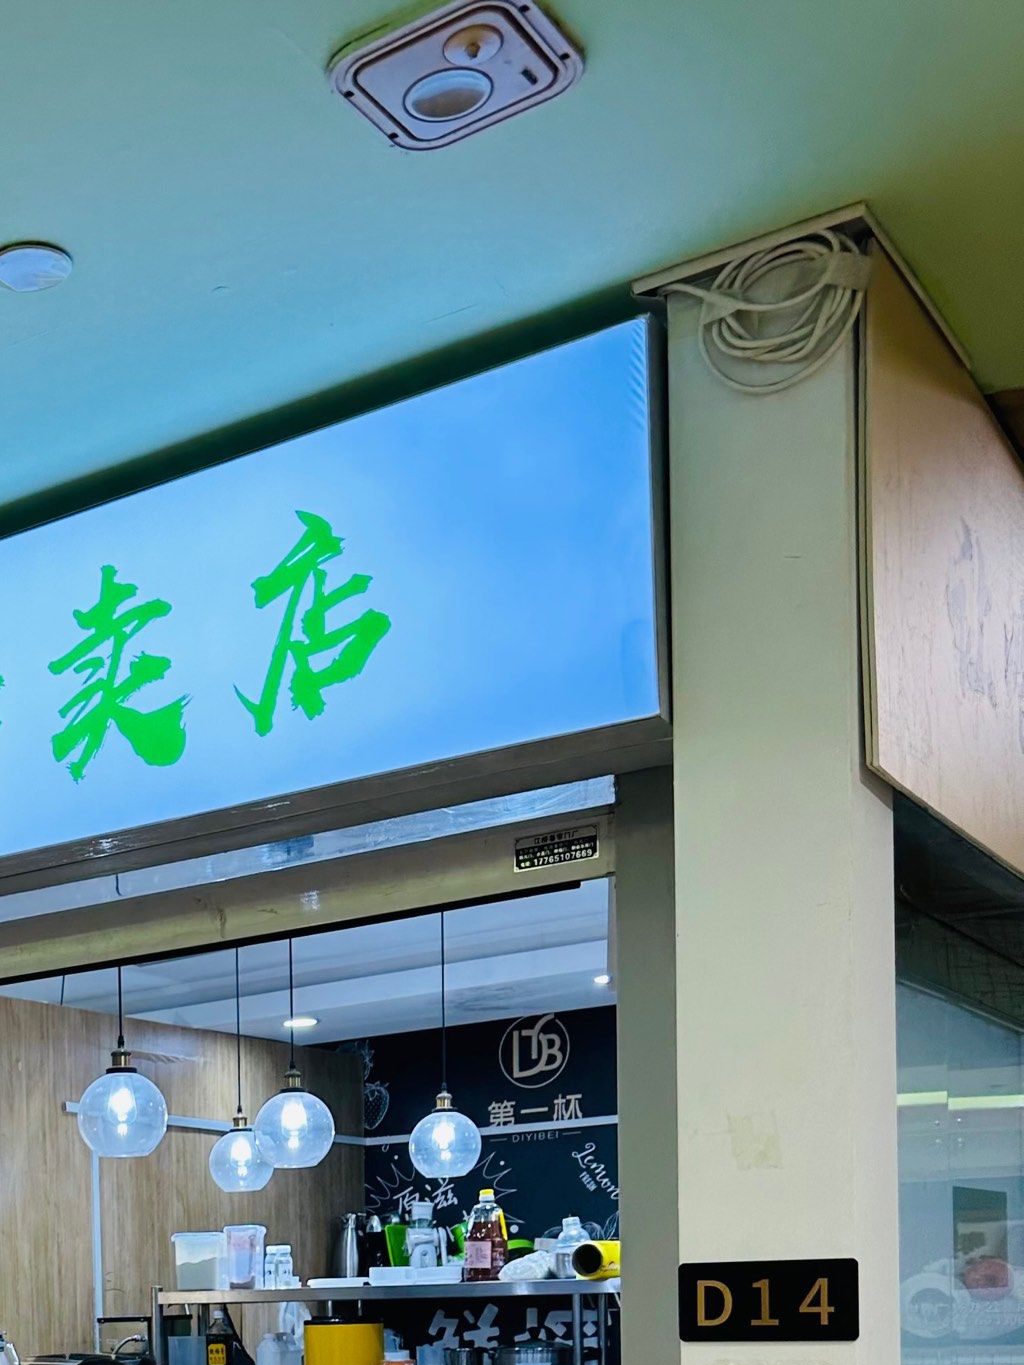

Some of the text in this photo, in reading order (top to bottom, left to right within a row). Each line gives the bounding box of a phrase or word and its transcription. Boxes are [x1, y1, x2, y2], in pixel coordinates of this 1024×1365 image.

[487, 1093, 584, 1128] 第一杯
[511, 1130, 560, 1143] DIYIBEI
[696, 1277, 836, 1327] D14
